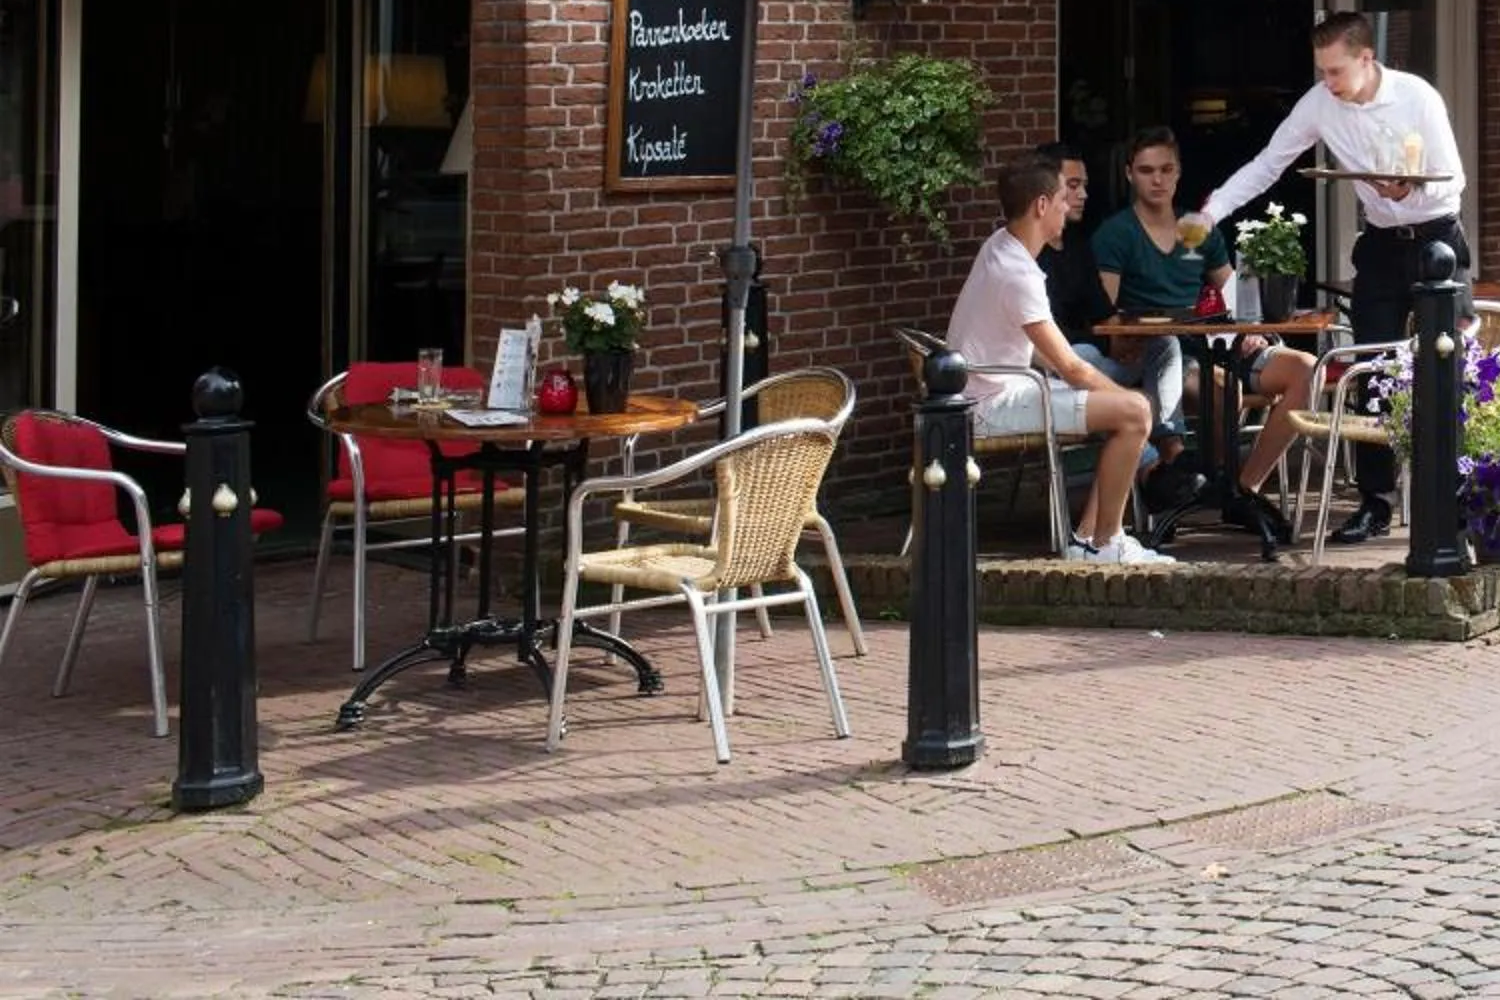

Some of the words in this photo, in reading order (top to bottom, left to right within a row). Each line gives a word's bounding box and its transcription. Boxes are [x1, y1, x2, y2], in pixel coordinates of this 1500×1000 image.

[629, 7, 732, 48] Pannenkoeken
[628, 61, 706, 102] Kroketten
[627, 124, 688, 175] Kipsaté
